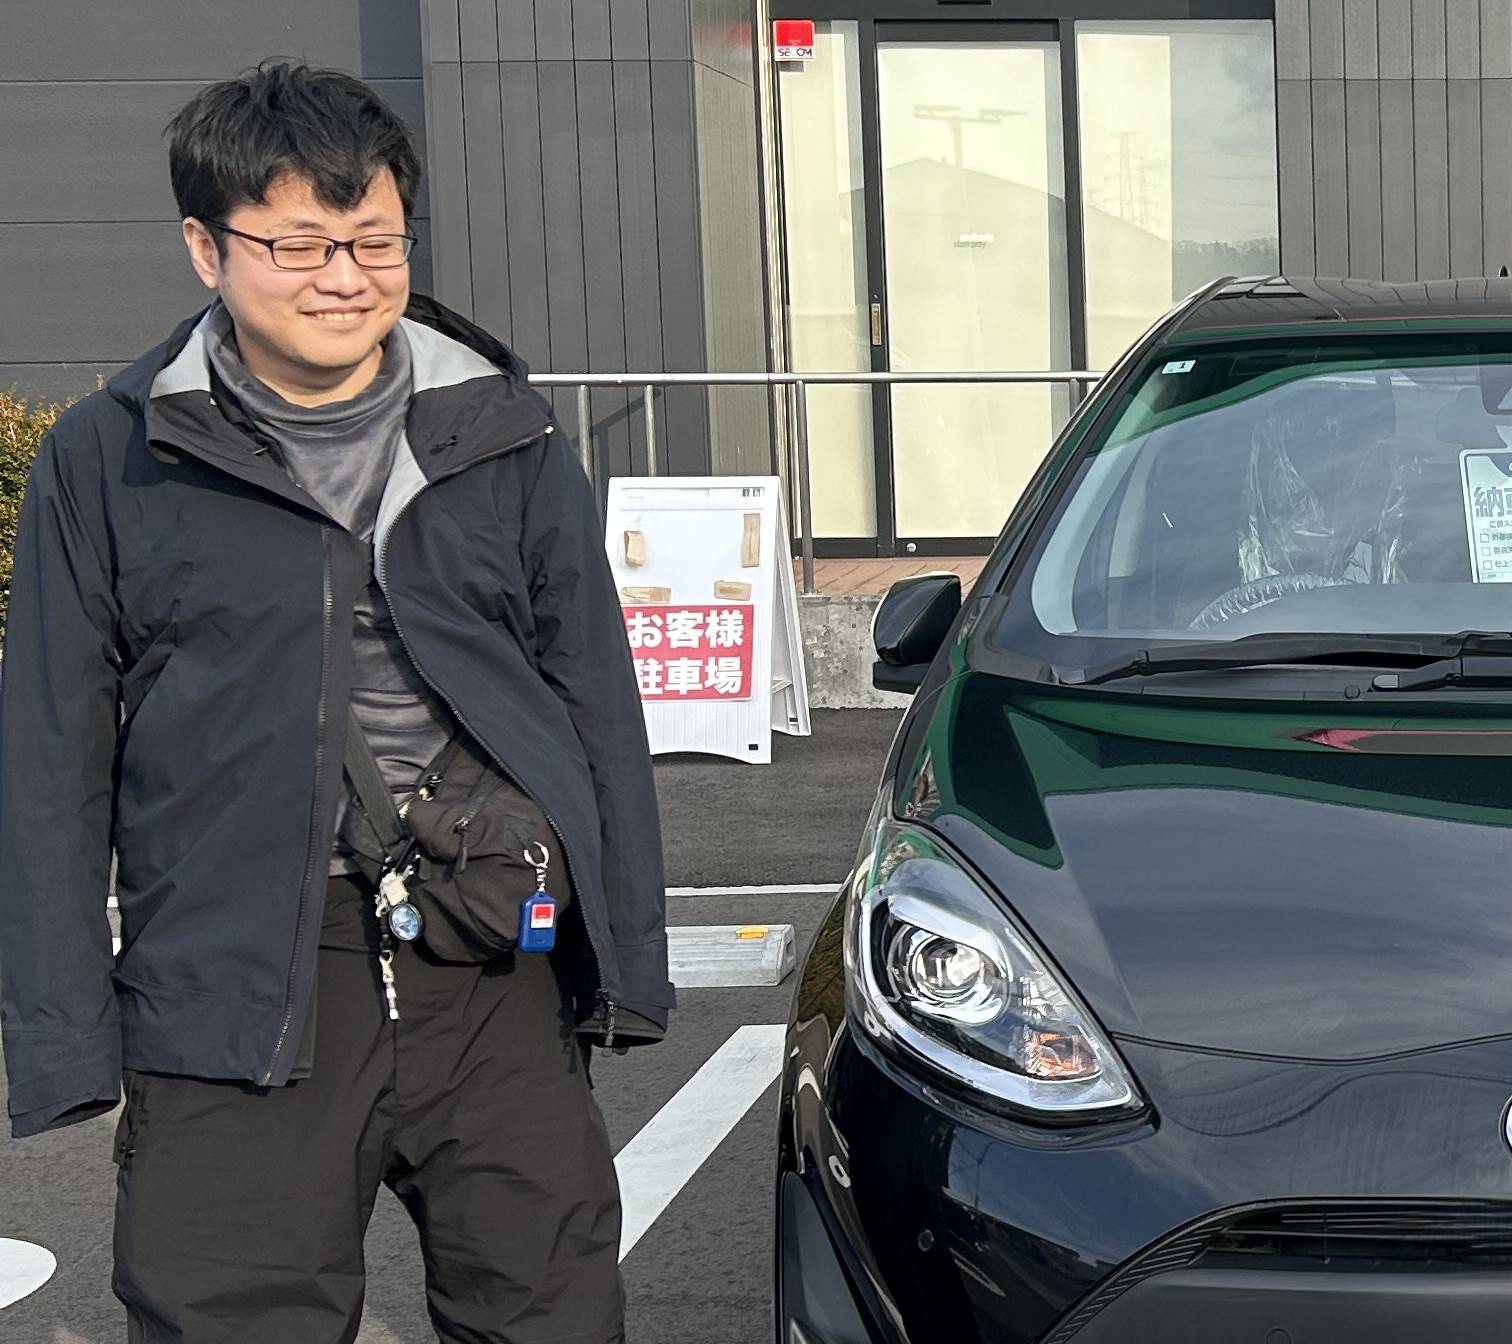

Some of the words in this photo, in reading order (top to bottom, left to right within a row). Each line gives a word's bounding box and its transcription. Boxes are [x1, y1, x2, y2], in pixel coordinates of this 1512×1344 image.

[777, 47, 813, 57] SEOM
[626, 609, 744, 648] お客様
[632, 656, 743, 695] 駐車場
